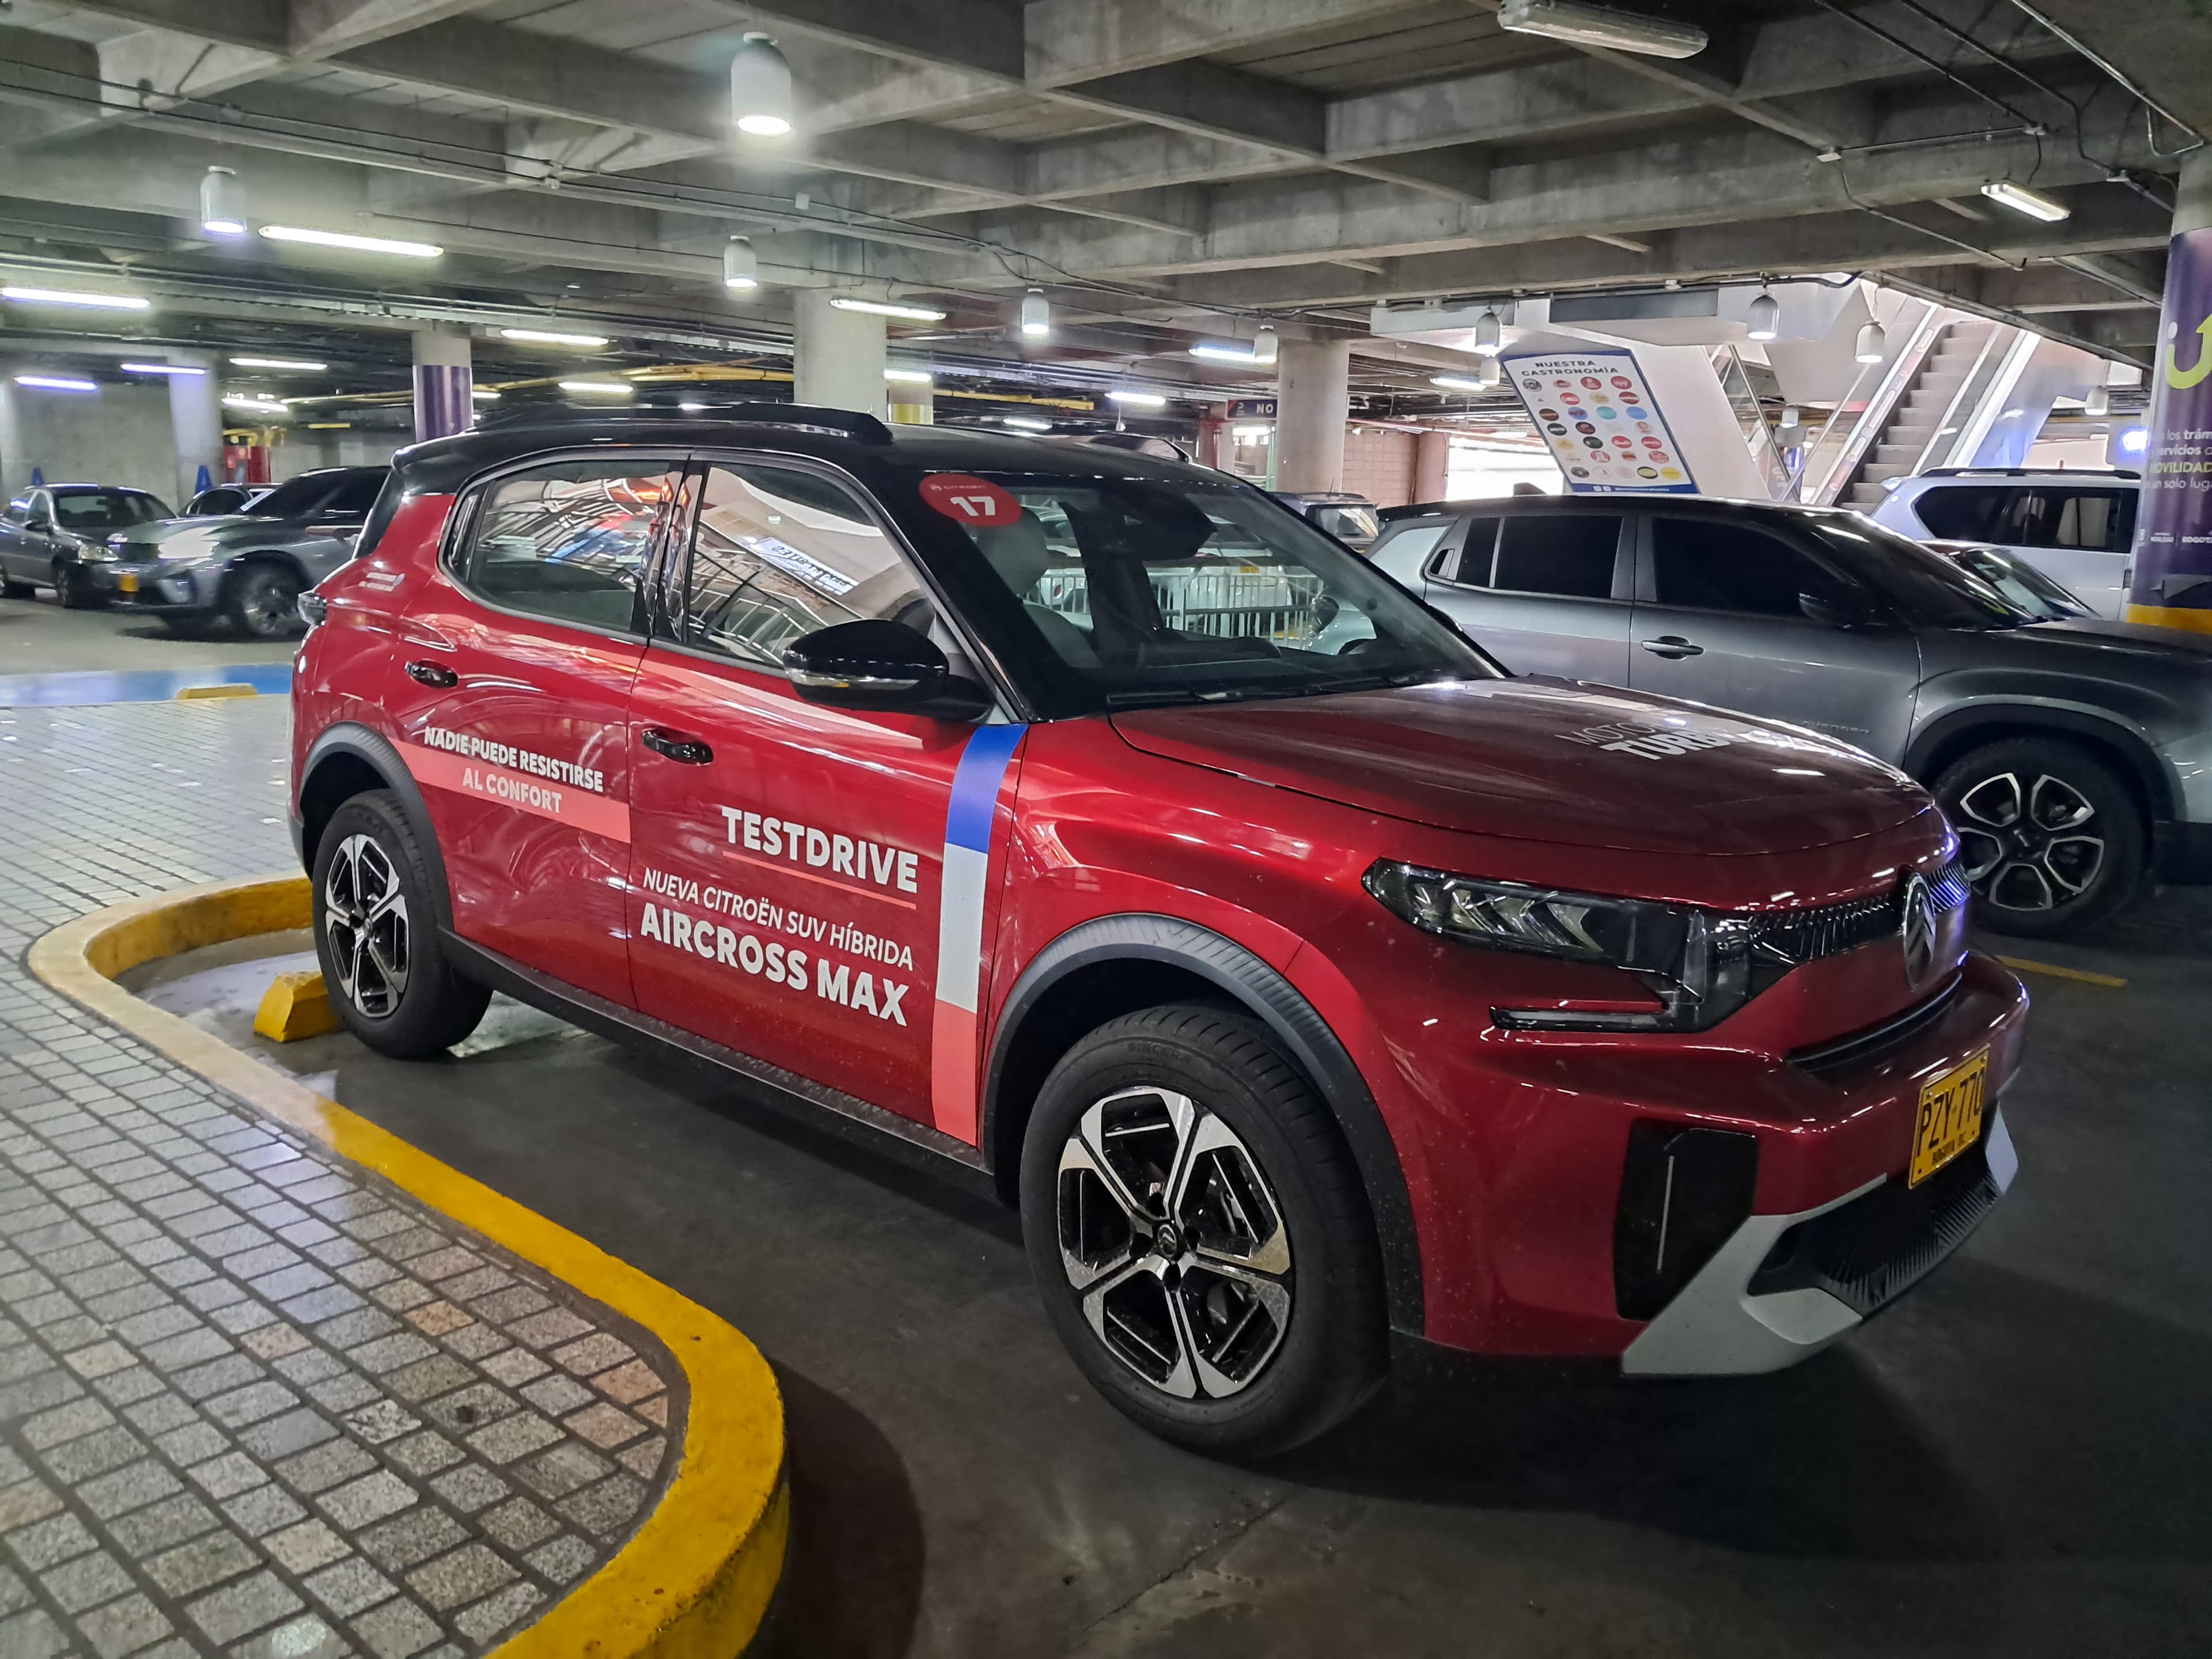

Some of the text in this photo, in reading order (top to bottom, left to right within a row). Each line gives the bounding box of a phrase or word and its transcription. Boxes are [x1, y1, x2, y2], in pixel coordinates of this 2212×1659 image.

[1521, 366, 1619, 376] GASTRONOMÍA
[1535, 360, 1596, 368] NUESTRA
[1256, 403, 1274, 414] NO
[2166, 429, 2181, 440] los
[2164, 476, 2187, 488] solo
[2190, 476, 2212, 492] lug
[950, 496, 995, 516] 17
[424, 726, 604, 793] NADIE PUEDE RESISTIRSE
[462, 767, 562, 813] AL CONFORT
[721, 806, 918, 893] TESTDRIVE
[642, 867, 913, 971] NUEVA CITROËN SUV HÍBRIDA
[641, 902, 909, 1027] AIRCROSS MAX
